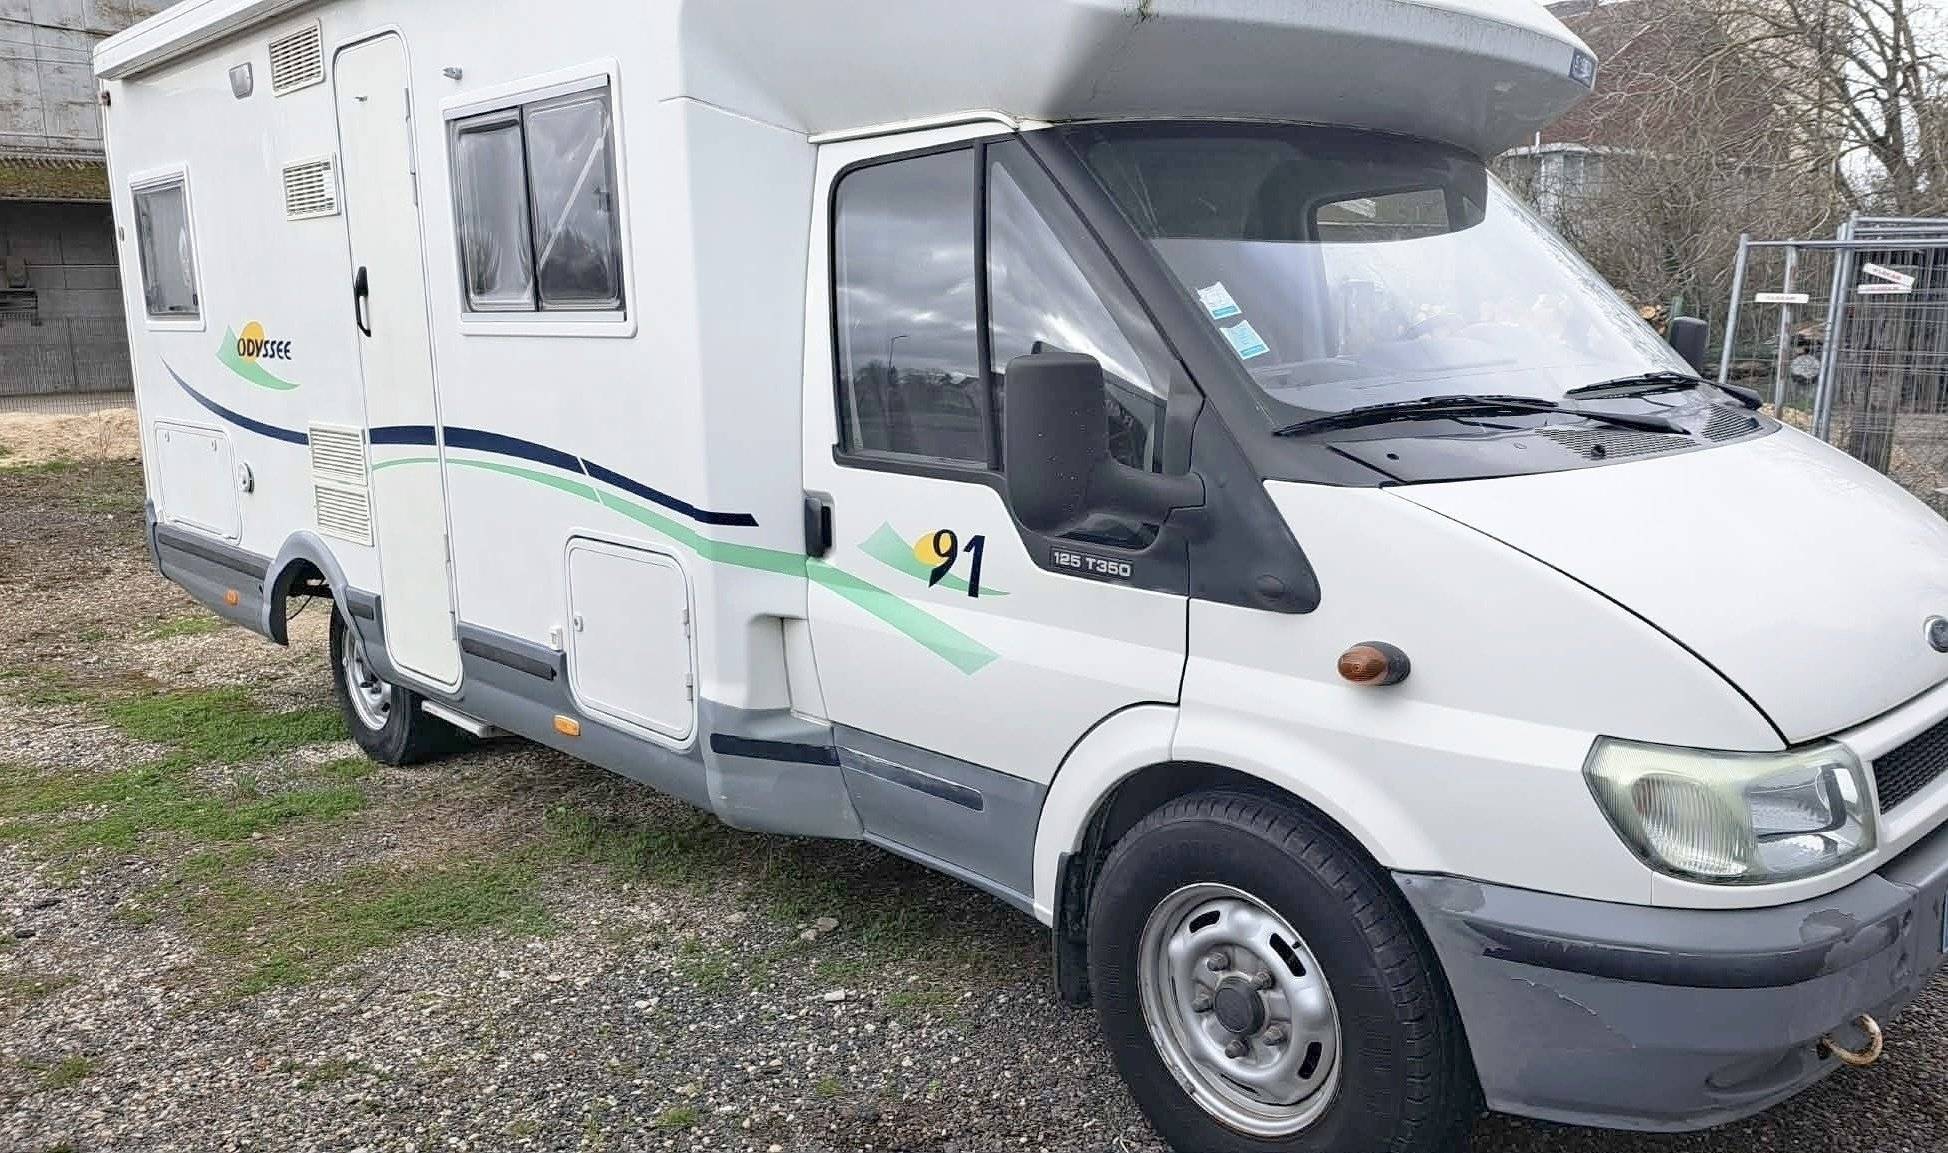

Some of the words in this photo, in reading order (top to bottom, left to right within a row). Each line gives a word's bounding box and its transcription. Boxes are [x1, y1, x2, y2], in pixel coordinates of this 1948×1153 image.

[237, 338, 292, 360] ODYSSEE
[928, 528, 985, 598] 91
[1054, 551, 1081, 568] 125
[1085, 557, 1131, 577] T350
